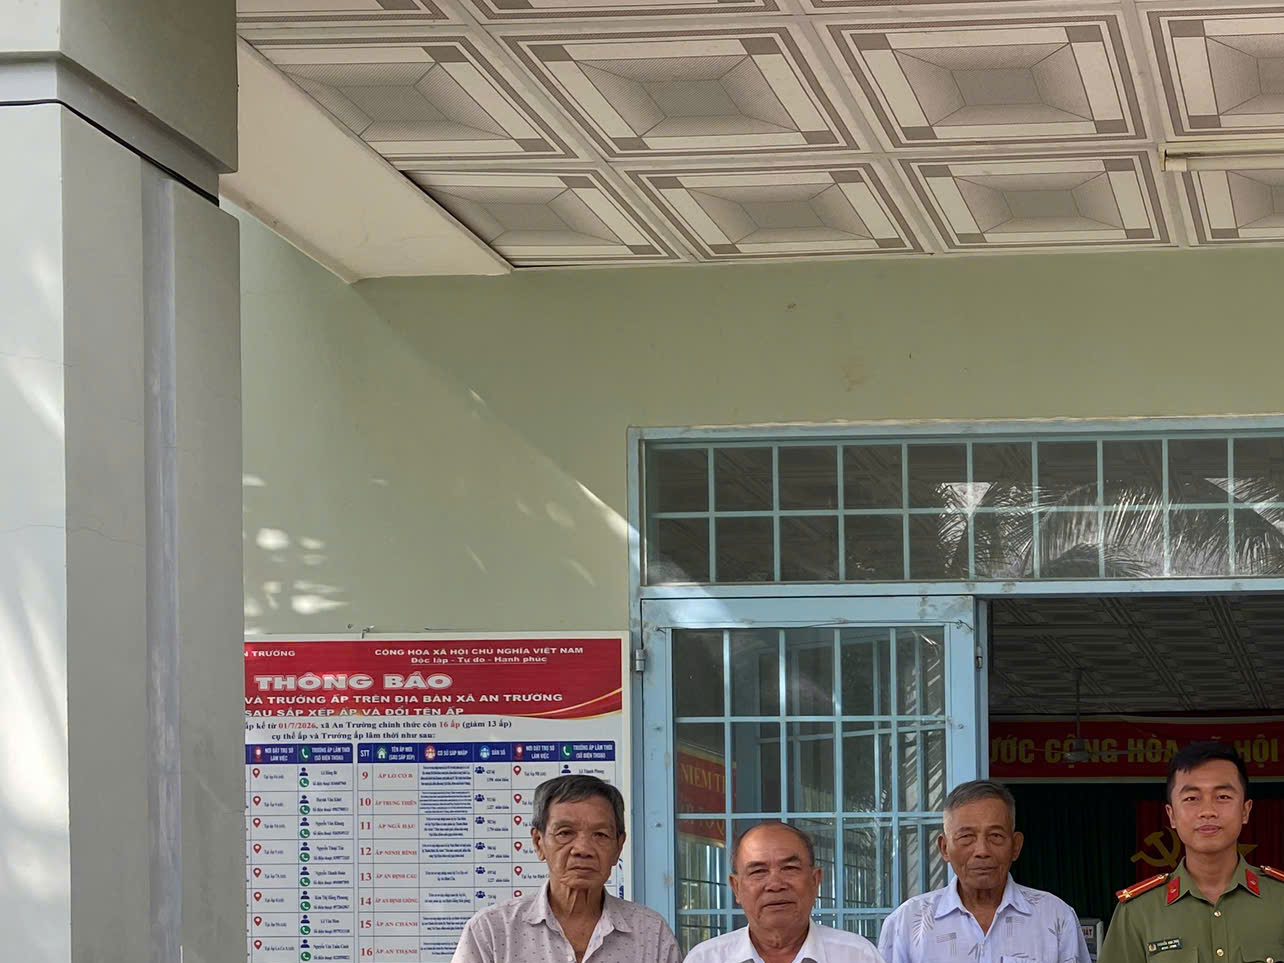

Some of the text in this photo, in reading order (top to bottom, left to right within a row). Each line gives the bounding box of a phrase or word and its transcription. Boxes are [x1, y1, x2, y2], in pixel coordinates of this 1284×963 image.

[254, 670, 453, 691] THÔNG BÁO
[479, 694, 499, 702] AN
[245, 709, 272, 717] SAU
[487, 720, 497, 728] 13
[360, 749, 370, 757] STT
[362, 771, 369, 780] 9
[360, 798, 371, 807] 10
[360, 822, 371, 830] 11
[360, 847, 372, 856] 12
[360, 872, 372, 881] 13
[360, 897, 372, 905] 14
[360, 920, 372, 928] 15
[360, 948, 373, 956] 16
